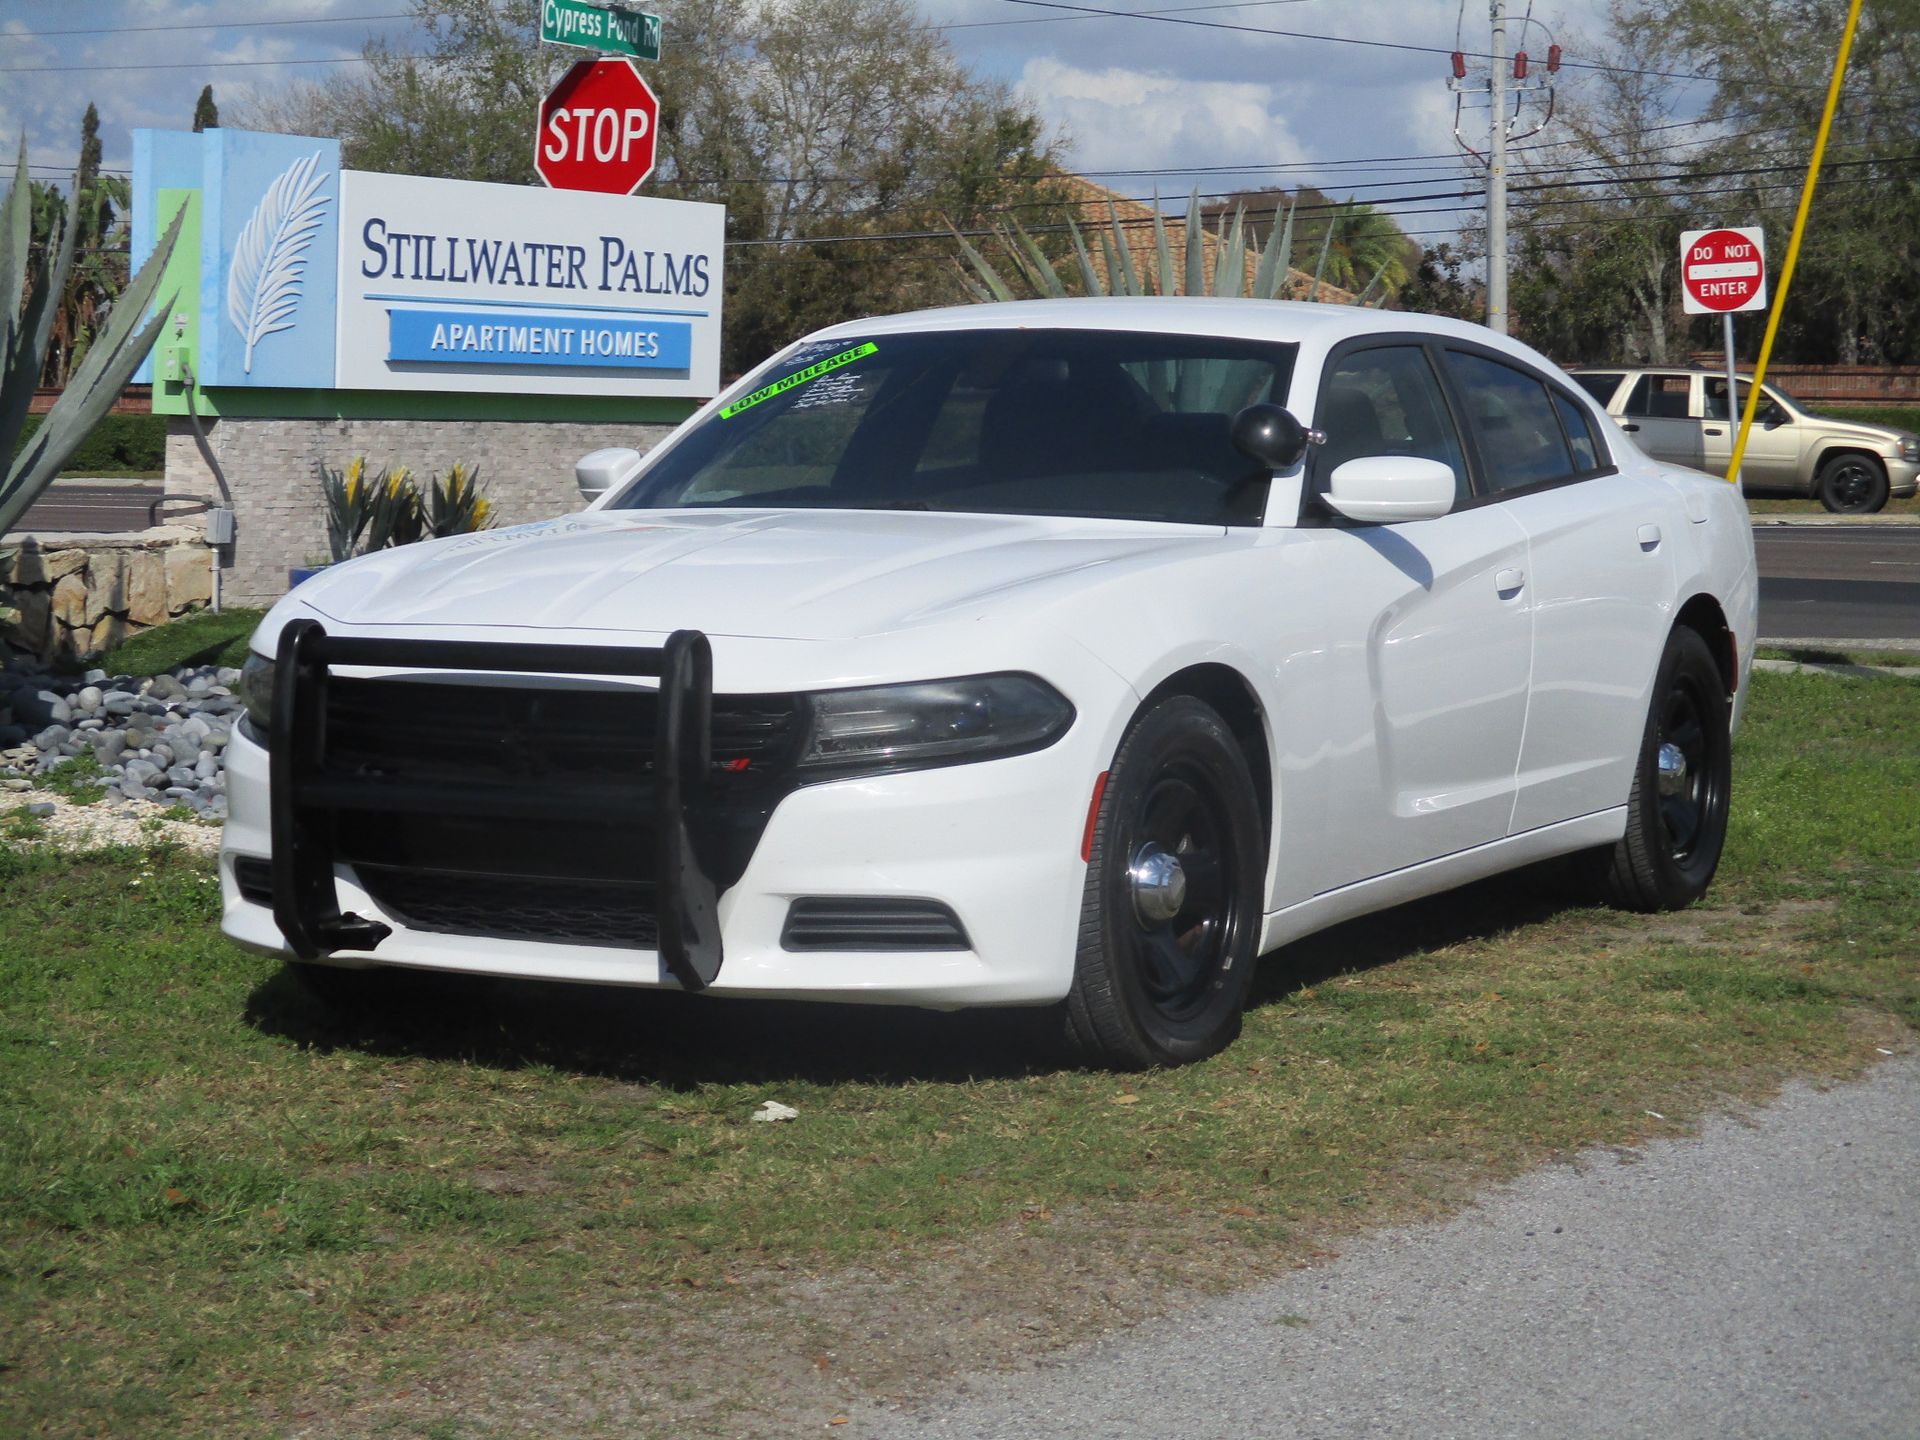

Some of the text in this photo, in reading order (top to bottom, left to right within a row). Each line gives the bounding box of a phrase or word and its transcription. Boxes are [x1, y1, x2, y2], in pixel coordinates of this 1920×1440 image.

[545, 0, 659, 48] Cypress Pond Rd
[545, 107, 649, 162] STOP
[361, 217, 710, 298] STILLWATER PALMS
[1694, 244, 1751, 260] DO NOT
[1701, 282, 1747, 296] ENTER
[430, 323, 660, 359] APARTMENT HOMES
[728, 387, 771, 415] LOW
[776, 346, 866, 391] MILEAGE
